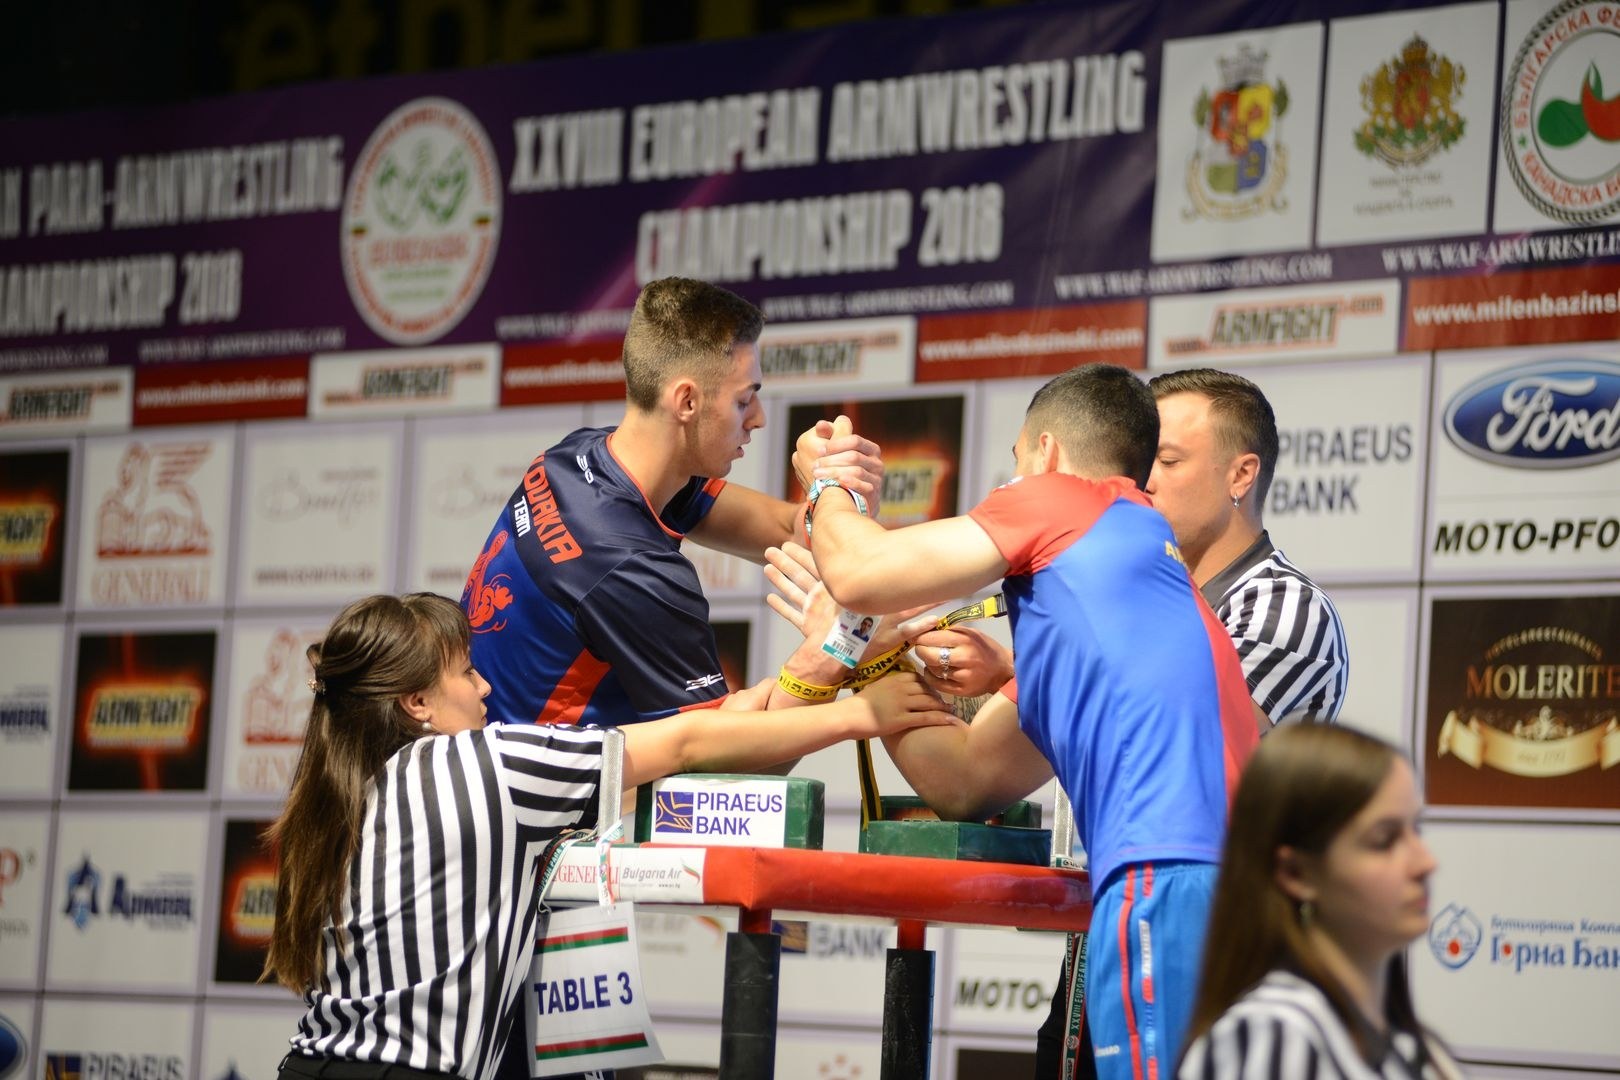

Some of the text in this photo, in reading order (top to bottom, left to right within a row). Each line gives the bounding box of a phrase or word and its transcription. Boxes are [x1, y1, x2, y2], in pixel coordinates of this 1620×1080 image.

[509, 107, 625, 194] XXVIII
[629, 85, 822, 183] EUROPEAN
[826, 50, 1148, 163] ARMWRESTLING
[636, 182, 1005, 288] CHAMPIONSHIP 2018
[0, 252, 177, 338] AMPIONSHIP
[1412, 288, 1620, 328] www.milenbazins
[1486, 376, 1620, 453] Ford
[1278, 423, 1413, 468] PIRAEUS
[1270, 475, 1362, 516] BANK
[1433, 518, 1620, 554] MOTO-PFO
[1466, 663, 1620, 700] MOLERITE
[696, 792, 783, 813] PIRAEUS
[695, 816, 751, 836] BANK
[557, 865, 619, 884] GENELI
[622, 867, 682, 882] Bulgaria Air
[811, 922, 888, 959] BANK
[534, 971, 633, 1016] TABLE 3
[953, 978, 1055, 1010] MOTO-
